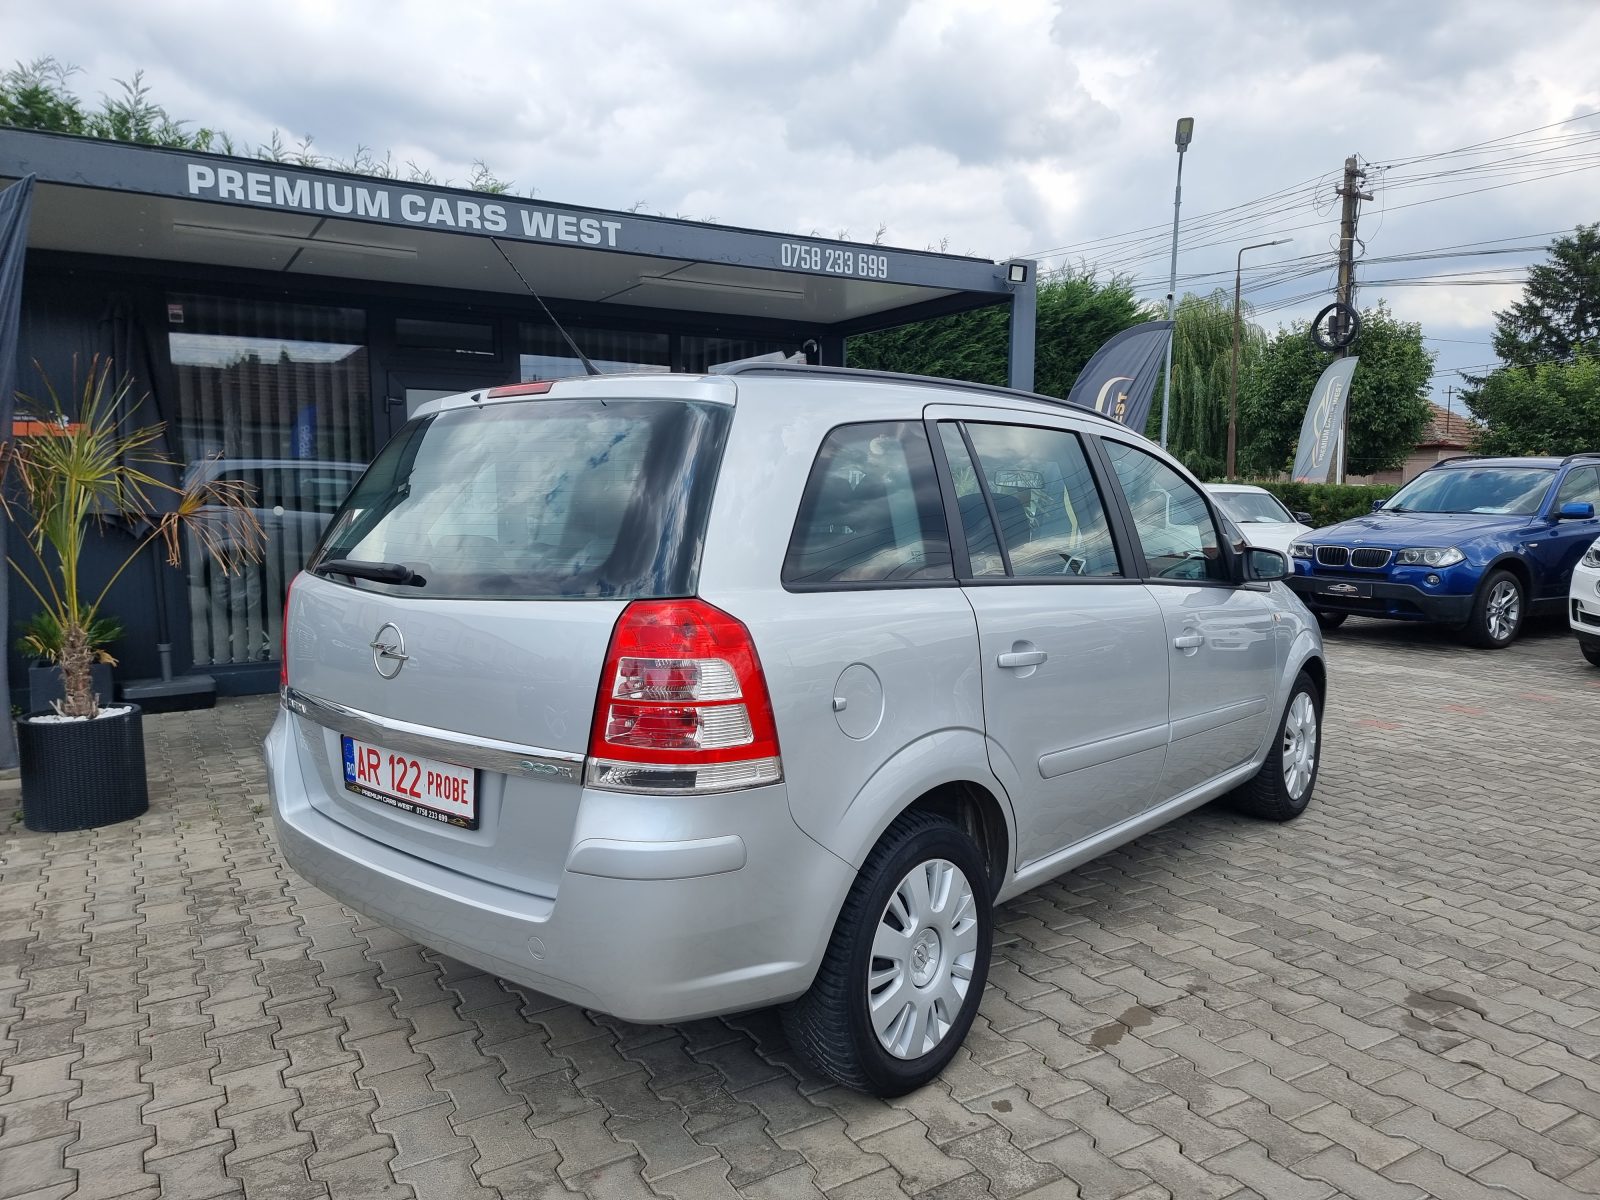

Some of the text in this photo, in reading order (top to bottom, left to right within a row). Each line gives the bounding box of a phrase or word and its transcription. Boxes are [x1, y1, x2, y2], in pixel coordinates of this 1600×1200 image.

[187, 163, 622, 248] PREMIUM CARS WEST
[781, 243, 888, 279] 0758 233 699
[346, 761, 356, 776] RO
[357, 745, 469, 805] AR 122 PROBE
[361, 788, 448, 823] PREMIUM CARS WEST 0758 233 699
